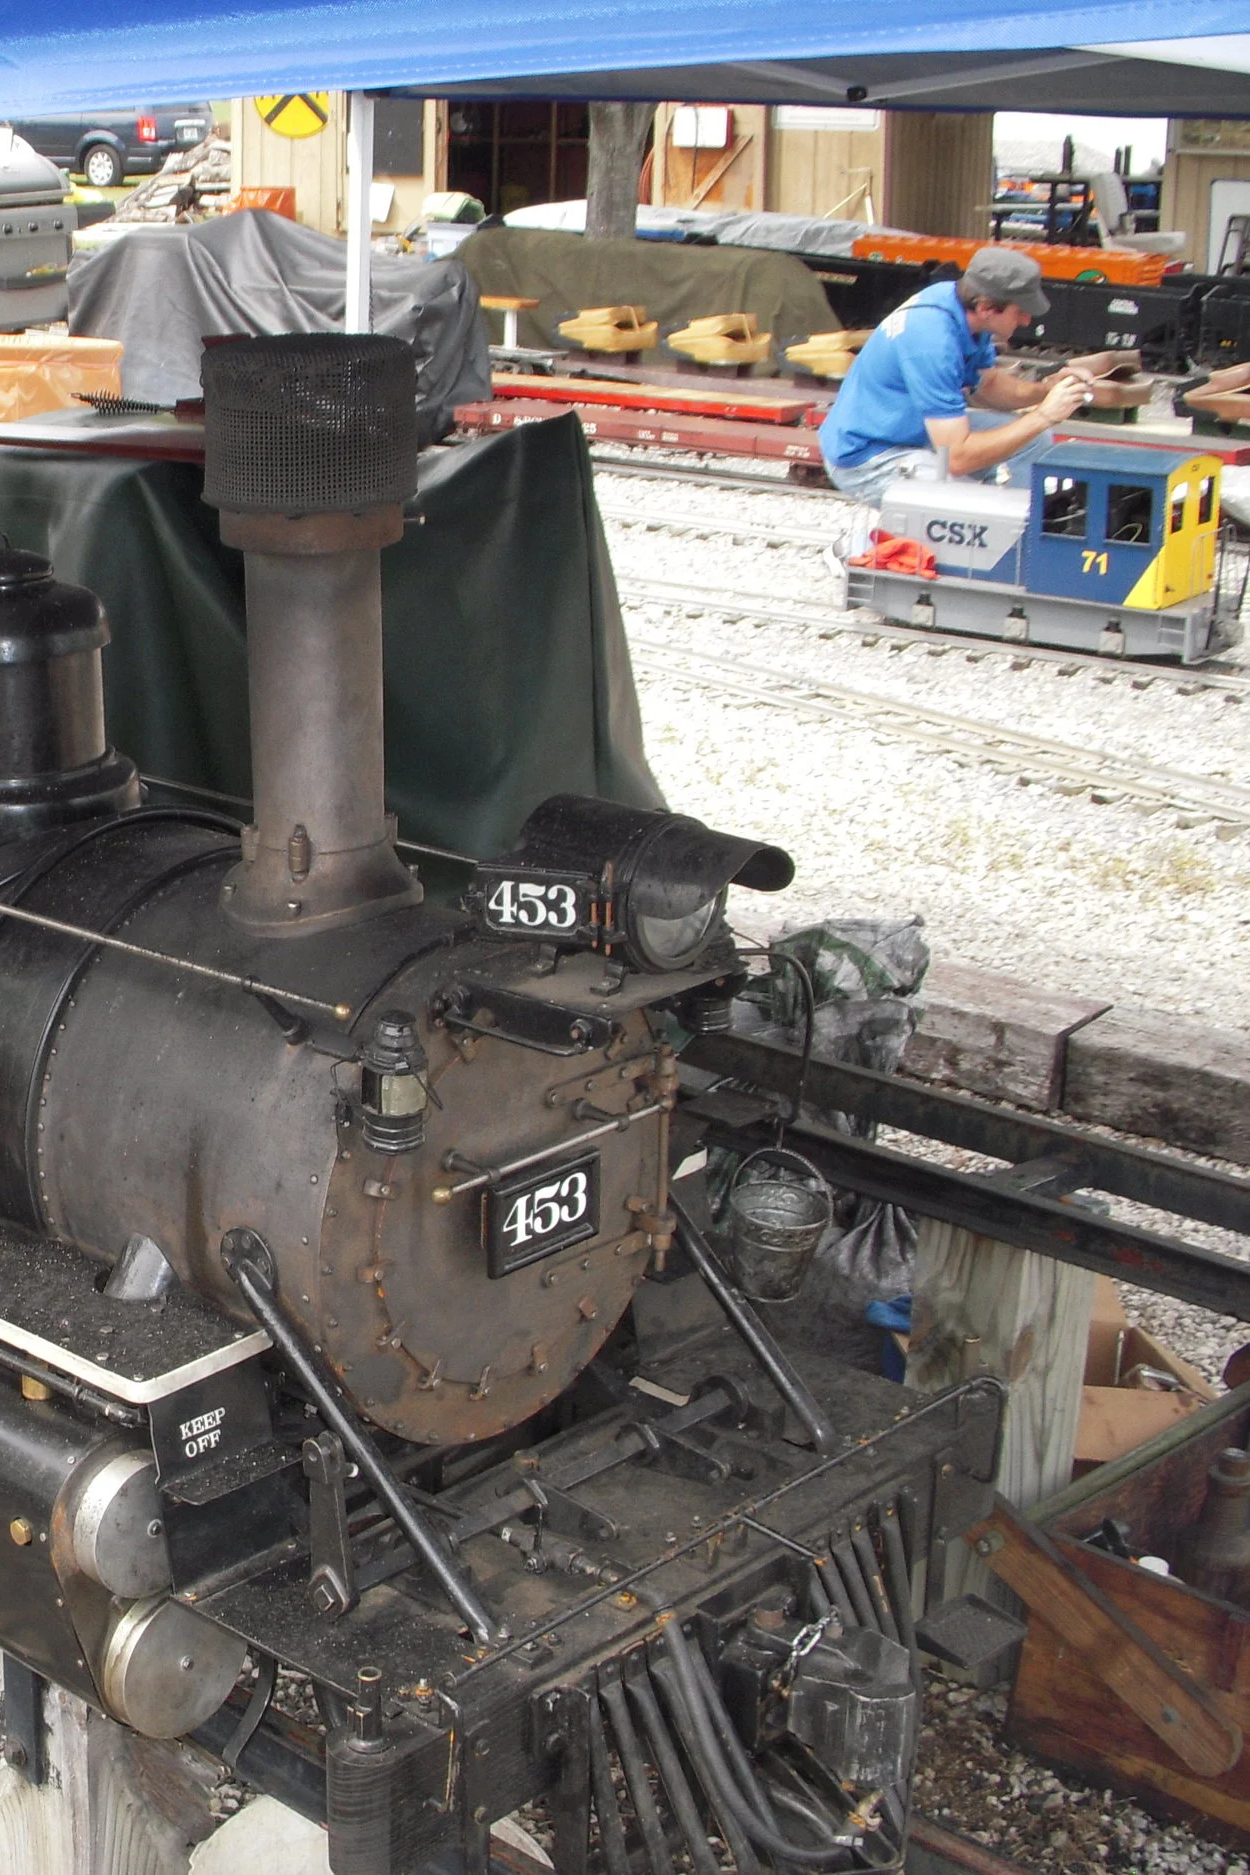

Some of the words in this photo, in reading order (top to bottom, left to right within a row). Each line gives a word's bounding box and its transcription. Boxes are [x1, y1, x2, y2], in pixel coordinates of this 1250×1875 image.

[926, 519, 989, 548] CSX
[1081, 550, 1108, 575] 71
[488, 880, 577, 928] 453
[502, 1171, 587, 1247] 453
[179, 1406, 226, 1440] KEEP
[185, 1429, 221, 1458] OFF
